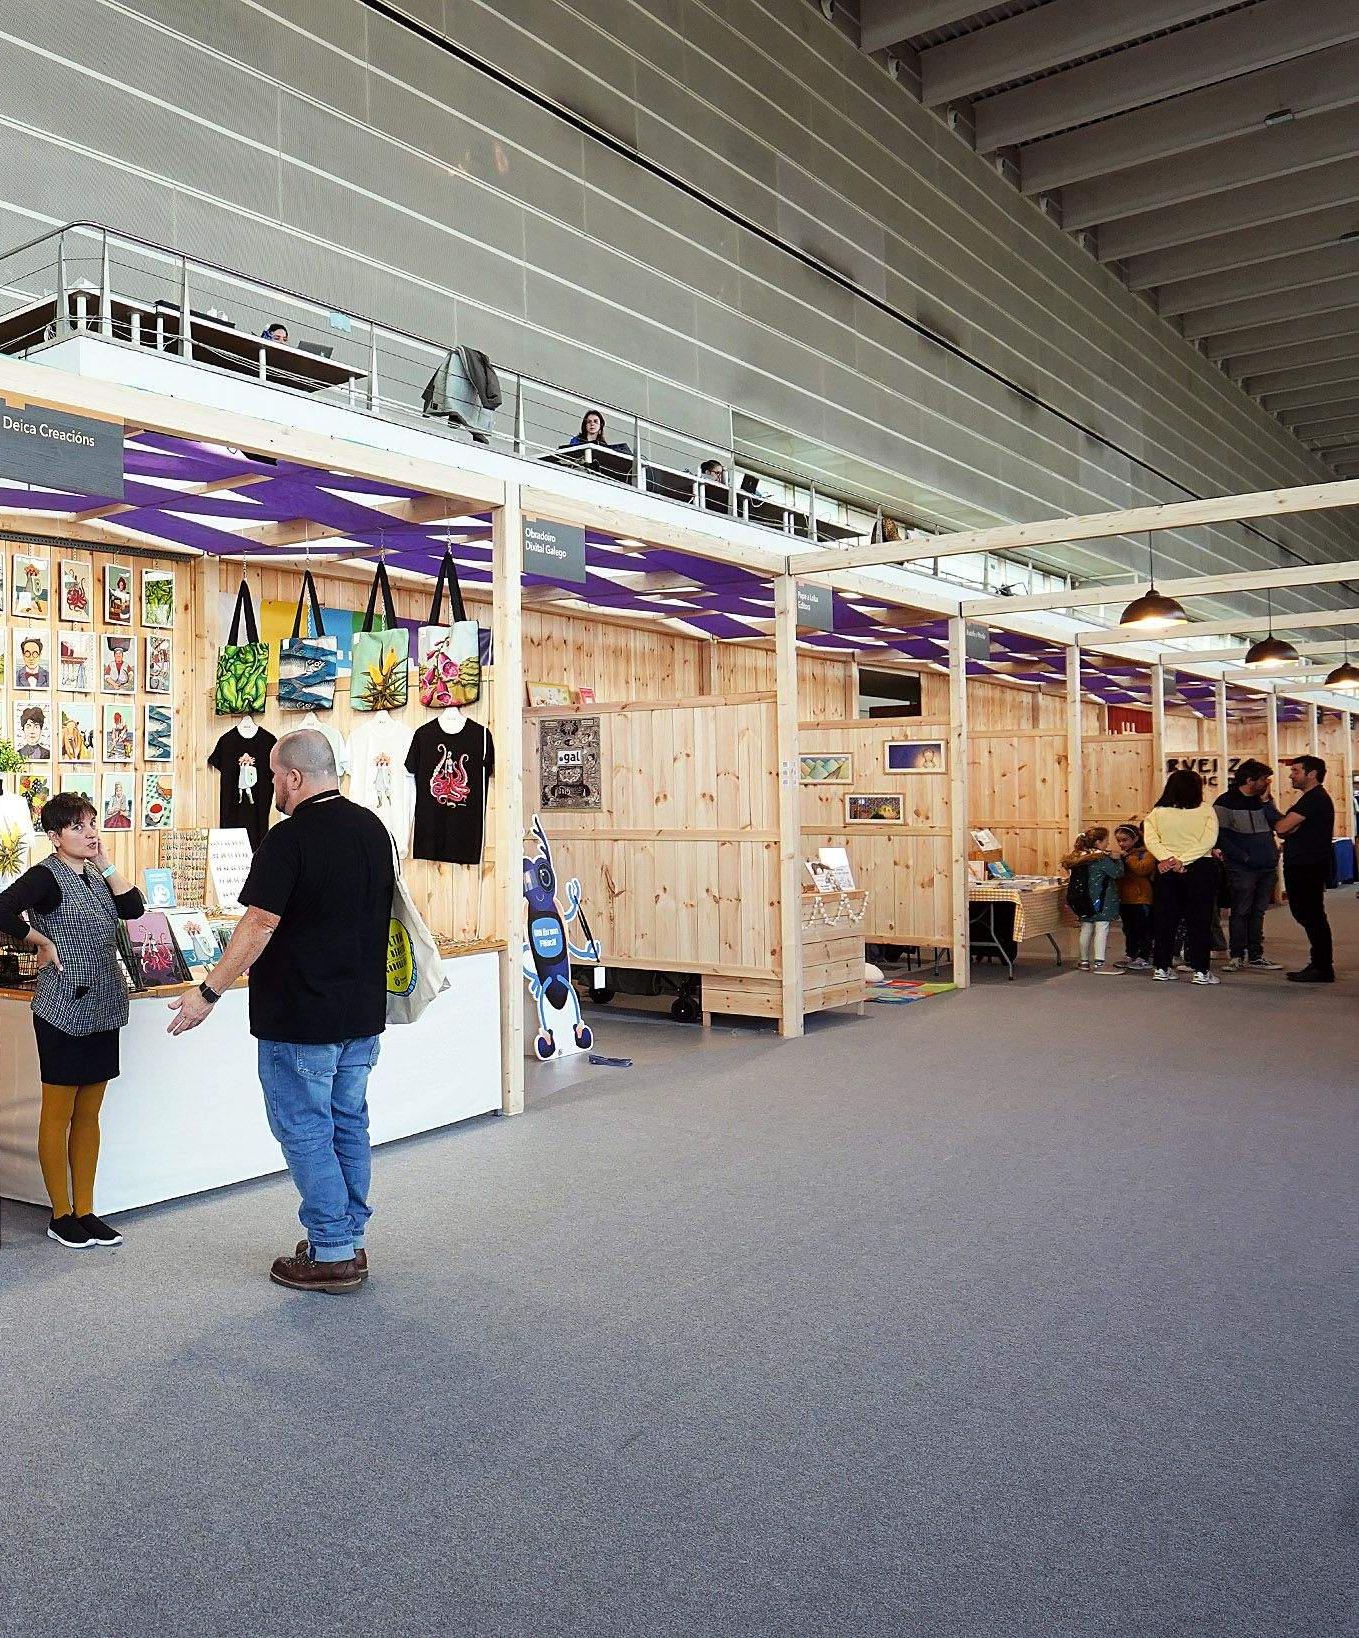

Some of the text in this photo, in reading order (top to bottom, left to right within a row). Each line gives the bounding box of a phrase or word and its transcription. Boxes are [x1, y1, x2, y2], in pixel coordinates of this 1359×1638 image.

[3, 415, 95, 447] Deica Creacións
[525, 527, 556, 543] Obradoiro
[525, 540, 567, 560] Dixital Galego
